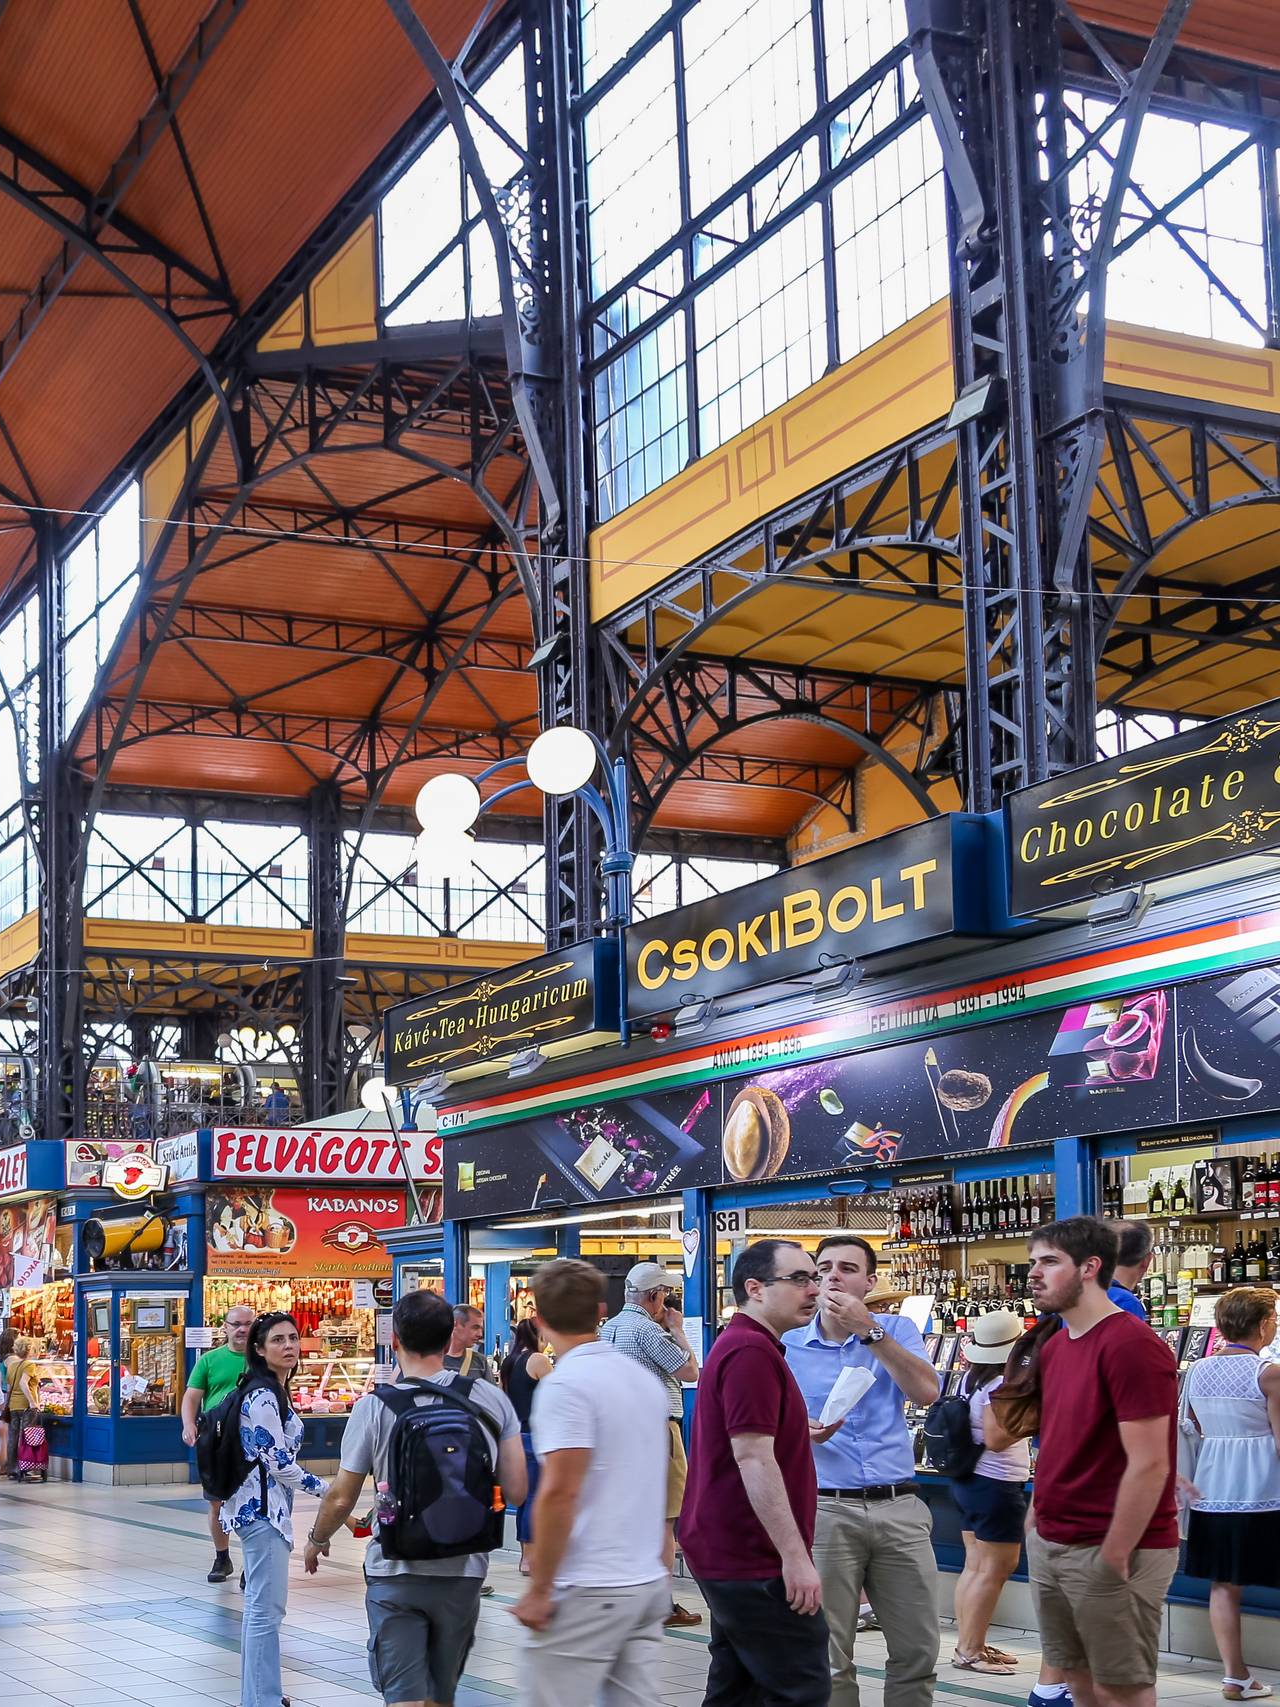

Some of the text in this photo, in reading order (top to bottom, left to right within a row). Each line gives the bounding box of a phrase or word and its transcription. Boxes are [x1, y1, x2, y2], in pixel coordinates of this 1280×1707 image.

[1020, 769, 1245, 863] Chocolate
[476, 977, 588, 1029] Hungaricum
[713, 1045, 741, 1070] ANNO
[180, 1142, 197, 1160] Attila
[216, 1132, 411, 1175] FELVÁGOTT
[308, 1197, 399, 1213] KABANOS
